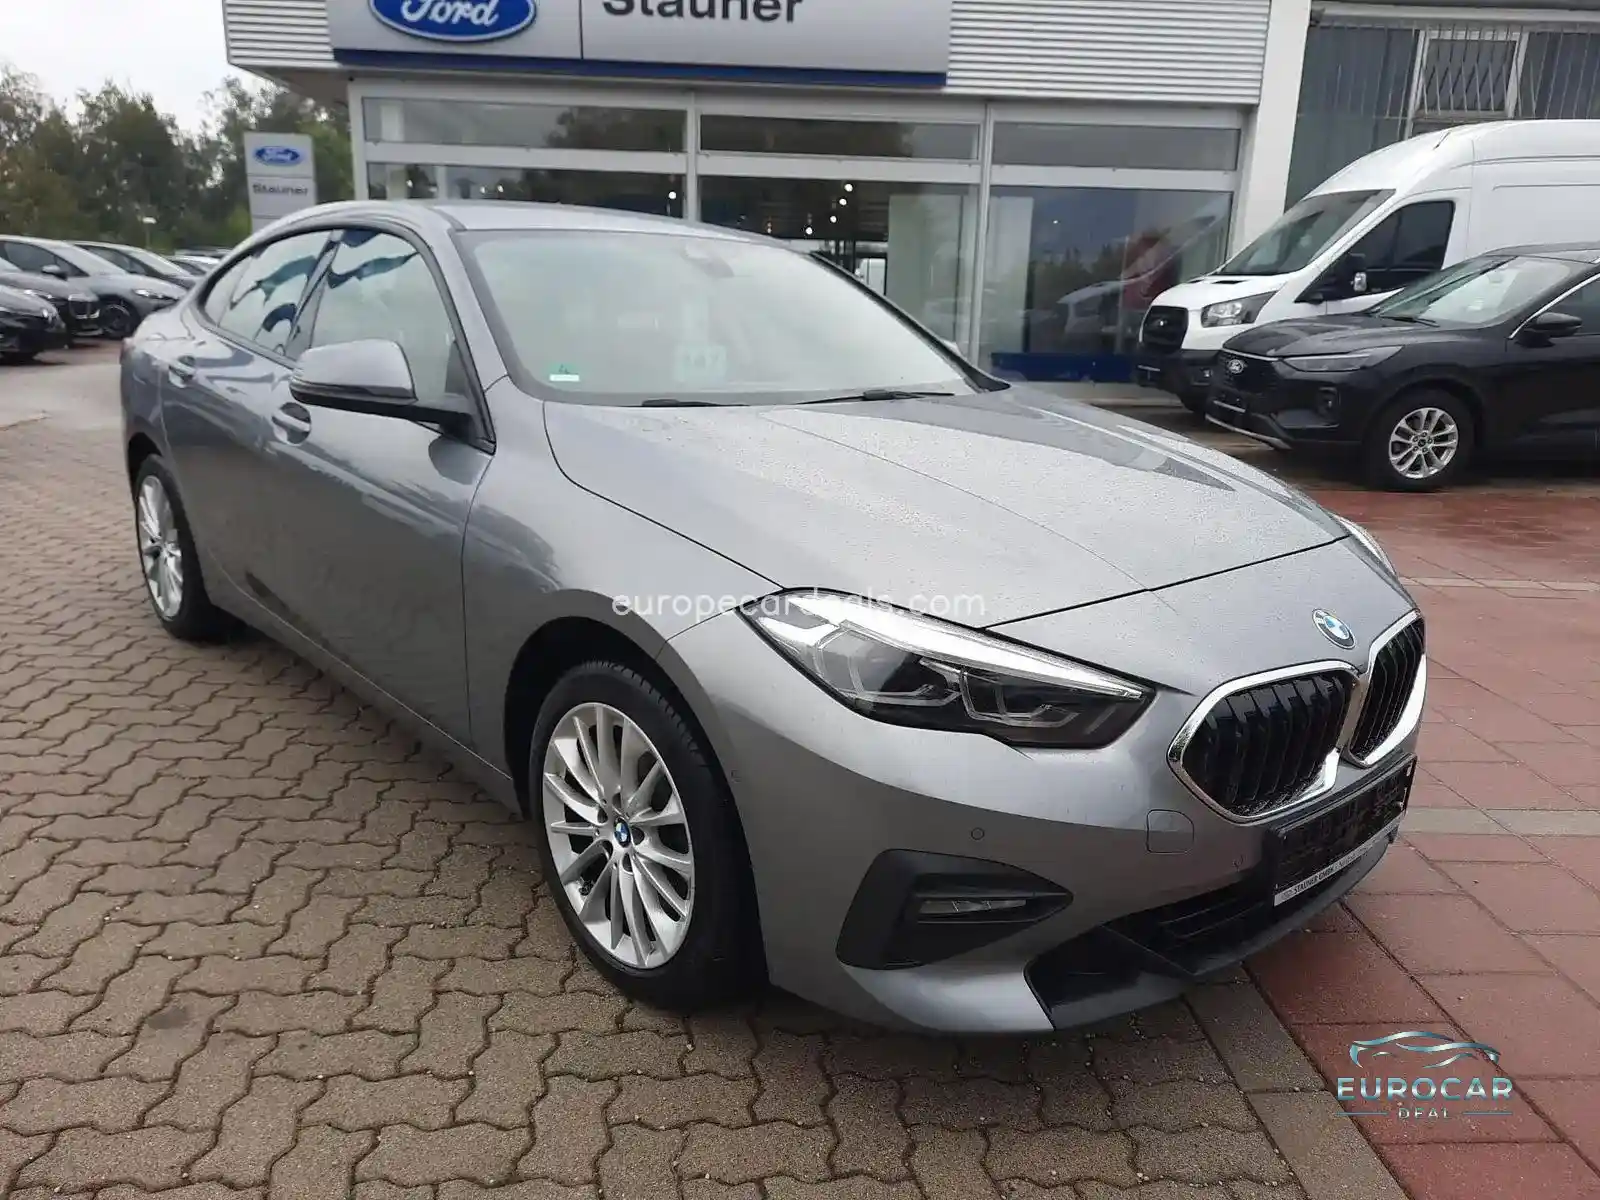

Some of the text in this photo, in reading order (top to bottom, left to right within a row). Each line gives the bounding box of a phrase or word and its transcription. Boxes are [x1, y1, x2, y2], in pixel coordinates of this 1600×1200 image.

[401, 0, 499, 26] Ford
[602, 0, 801, 23] Stauner
[252, 183, 308, 197] Stauner
